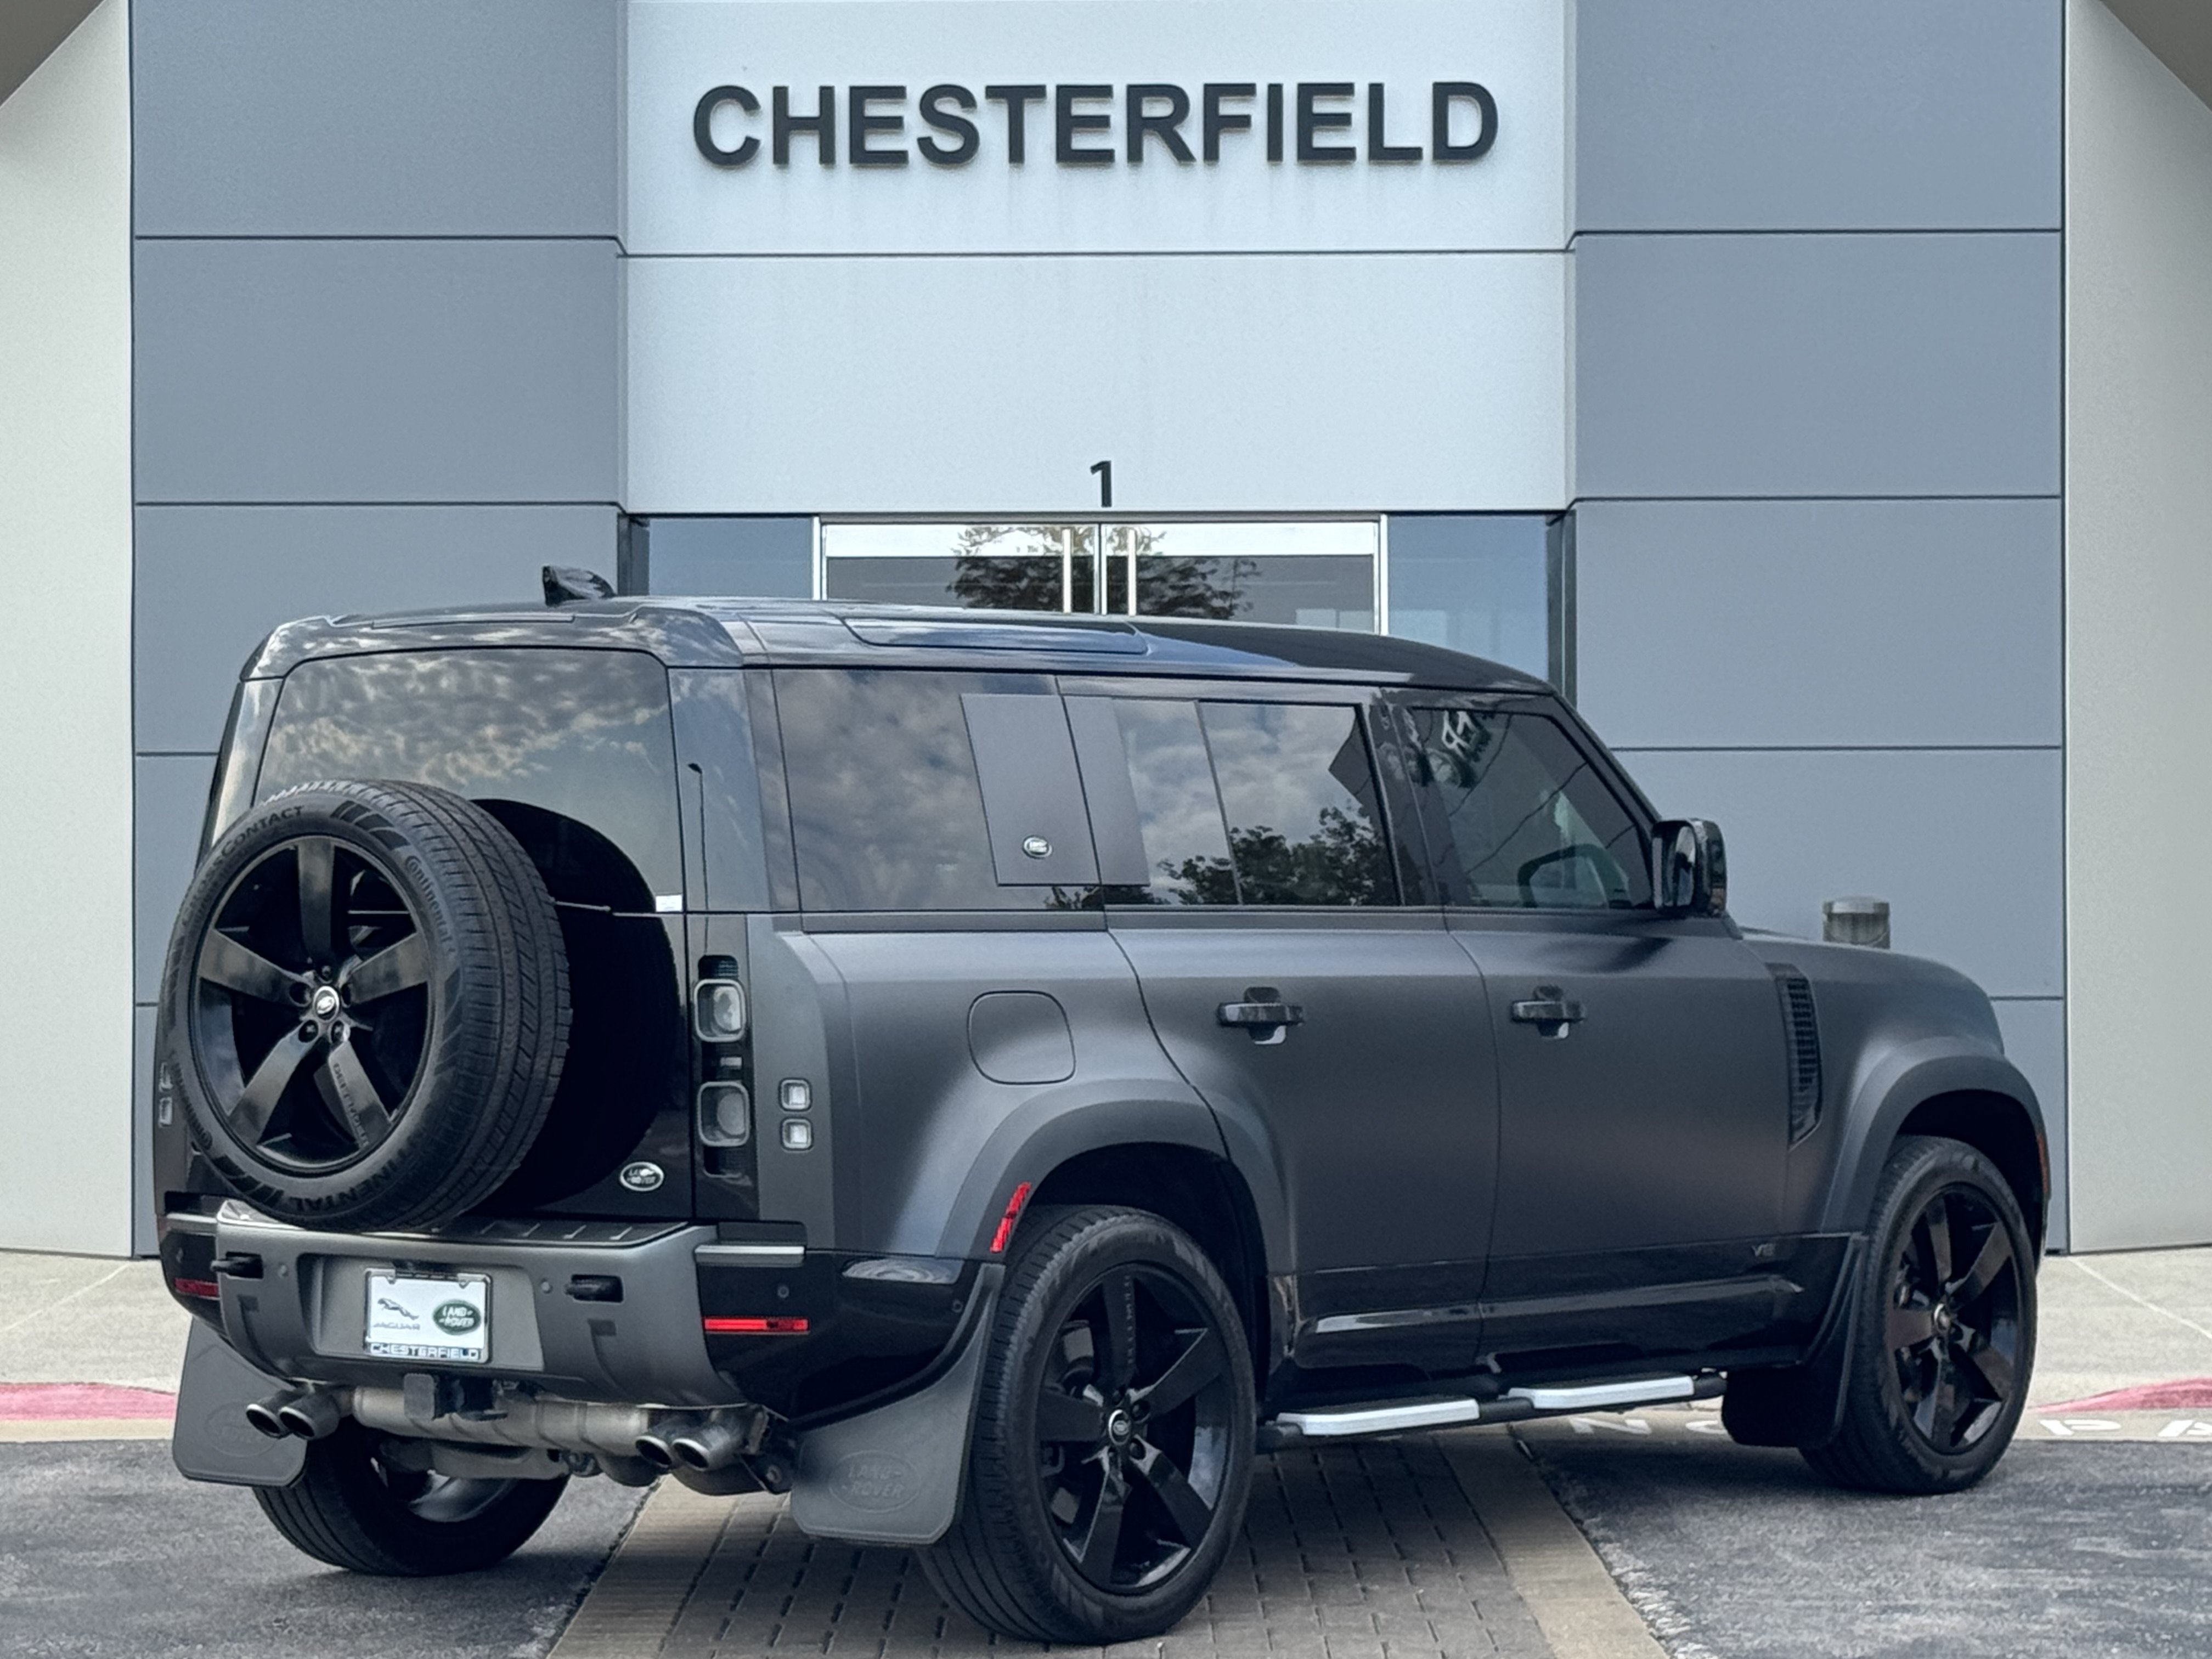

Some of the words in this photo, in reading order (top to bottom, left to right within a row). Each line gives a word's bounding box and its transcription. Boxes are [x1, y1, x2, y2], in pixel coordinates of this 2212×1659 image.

[692, 82, 1499, 166] CHESTERFIELD
[1090, 460, 1112, 508] 1
[373, 1321, 421, 1331] JAGUAR
[370, 1342, 479, 1361] CHESTERFIELD
